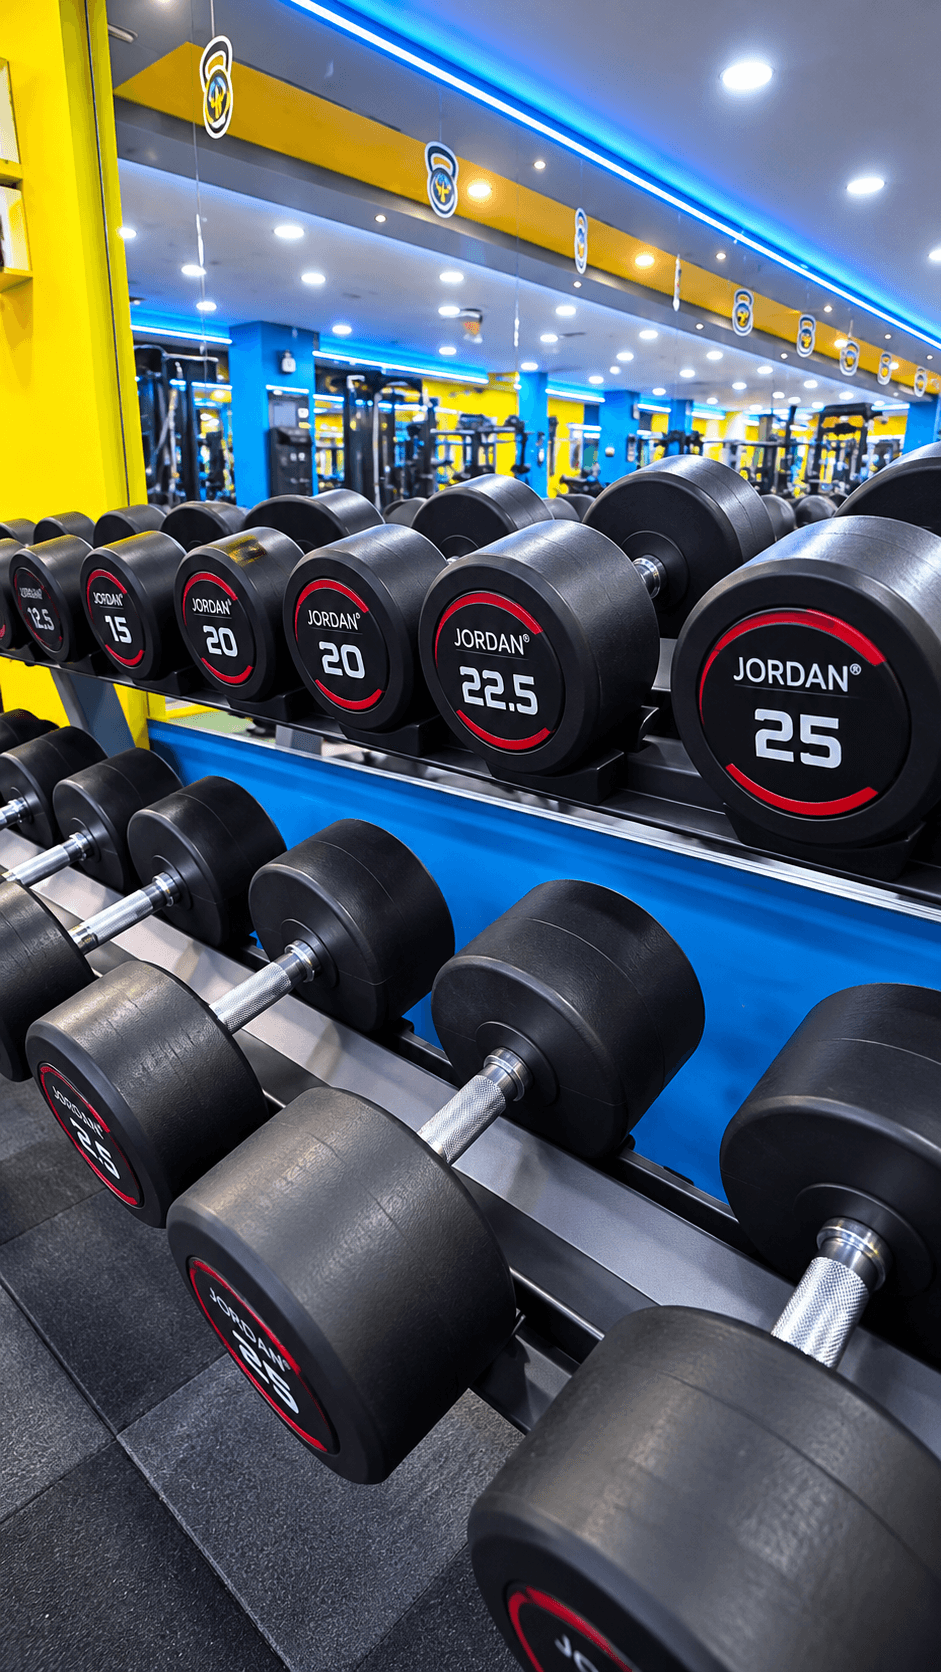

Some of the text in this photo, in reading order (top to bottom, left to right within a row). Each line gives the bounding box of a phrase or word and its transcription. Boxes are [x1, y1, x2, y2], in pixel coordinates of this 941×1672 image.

[27, 607, 55, 631] 12.5
[105, 615, 132, 644] 15
[202, 625, 238, 657] 20
[318, 641, 366, 679] 20
[459, 665, 538, 716] 22.5
[754, 708, 842, 769] 25
[232, 1330, 300, 1415] 25
